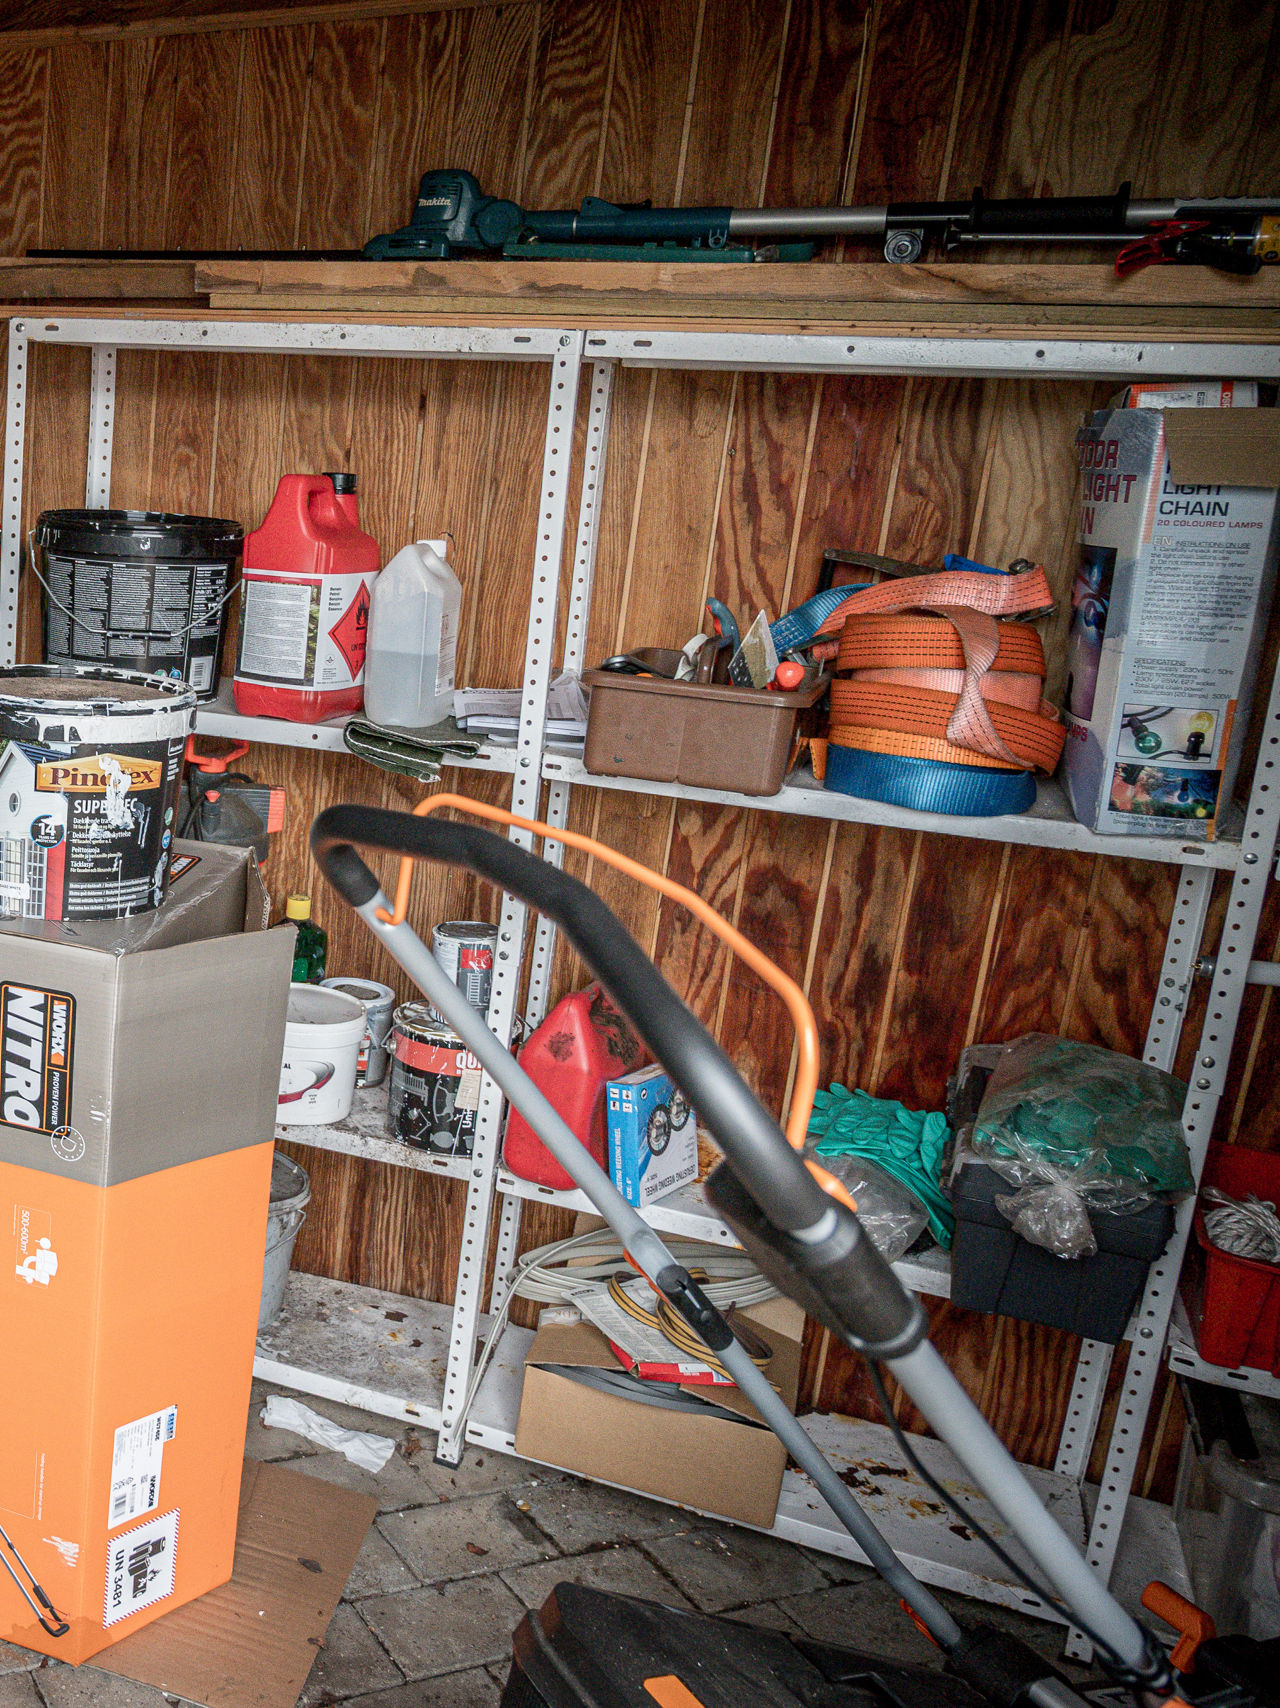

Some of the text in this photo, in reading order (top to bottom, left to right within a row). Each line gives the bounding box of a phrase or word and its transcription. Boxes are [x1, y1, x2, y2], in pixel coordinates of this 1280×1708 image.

[419, 197, 452, 207] makita
[1160, 501, 1230, 517] CHAIN
[1173, 520, 1225, 528] COLOURED
[1229, 521, 1264, 529] LAMPS
[1153, 535, 1172, 546] EN
[1134, 657, 1187, 667] SPECIFICATIONS
[38, 822, 56, 836] 14
[51, 1003, 67, 1058] WORX
[4, 986, 46, 1129] NITRO
[50, 1071, 60, 1126] PROVEN POWER
[644, 1183, 659, 1197] WHEEL
[658, 1175, 676, 1191] WEEDING
[111, 1549, 126, 1609] UN 3481
